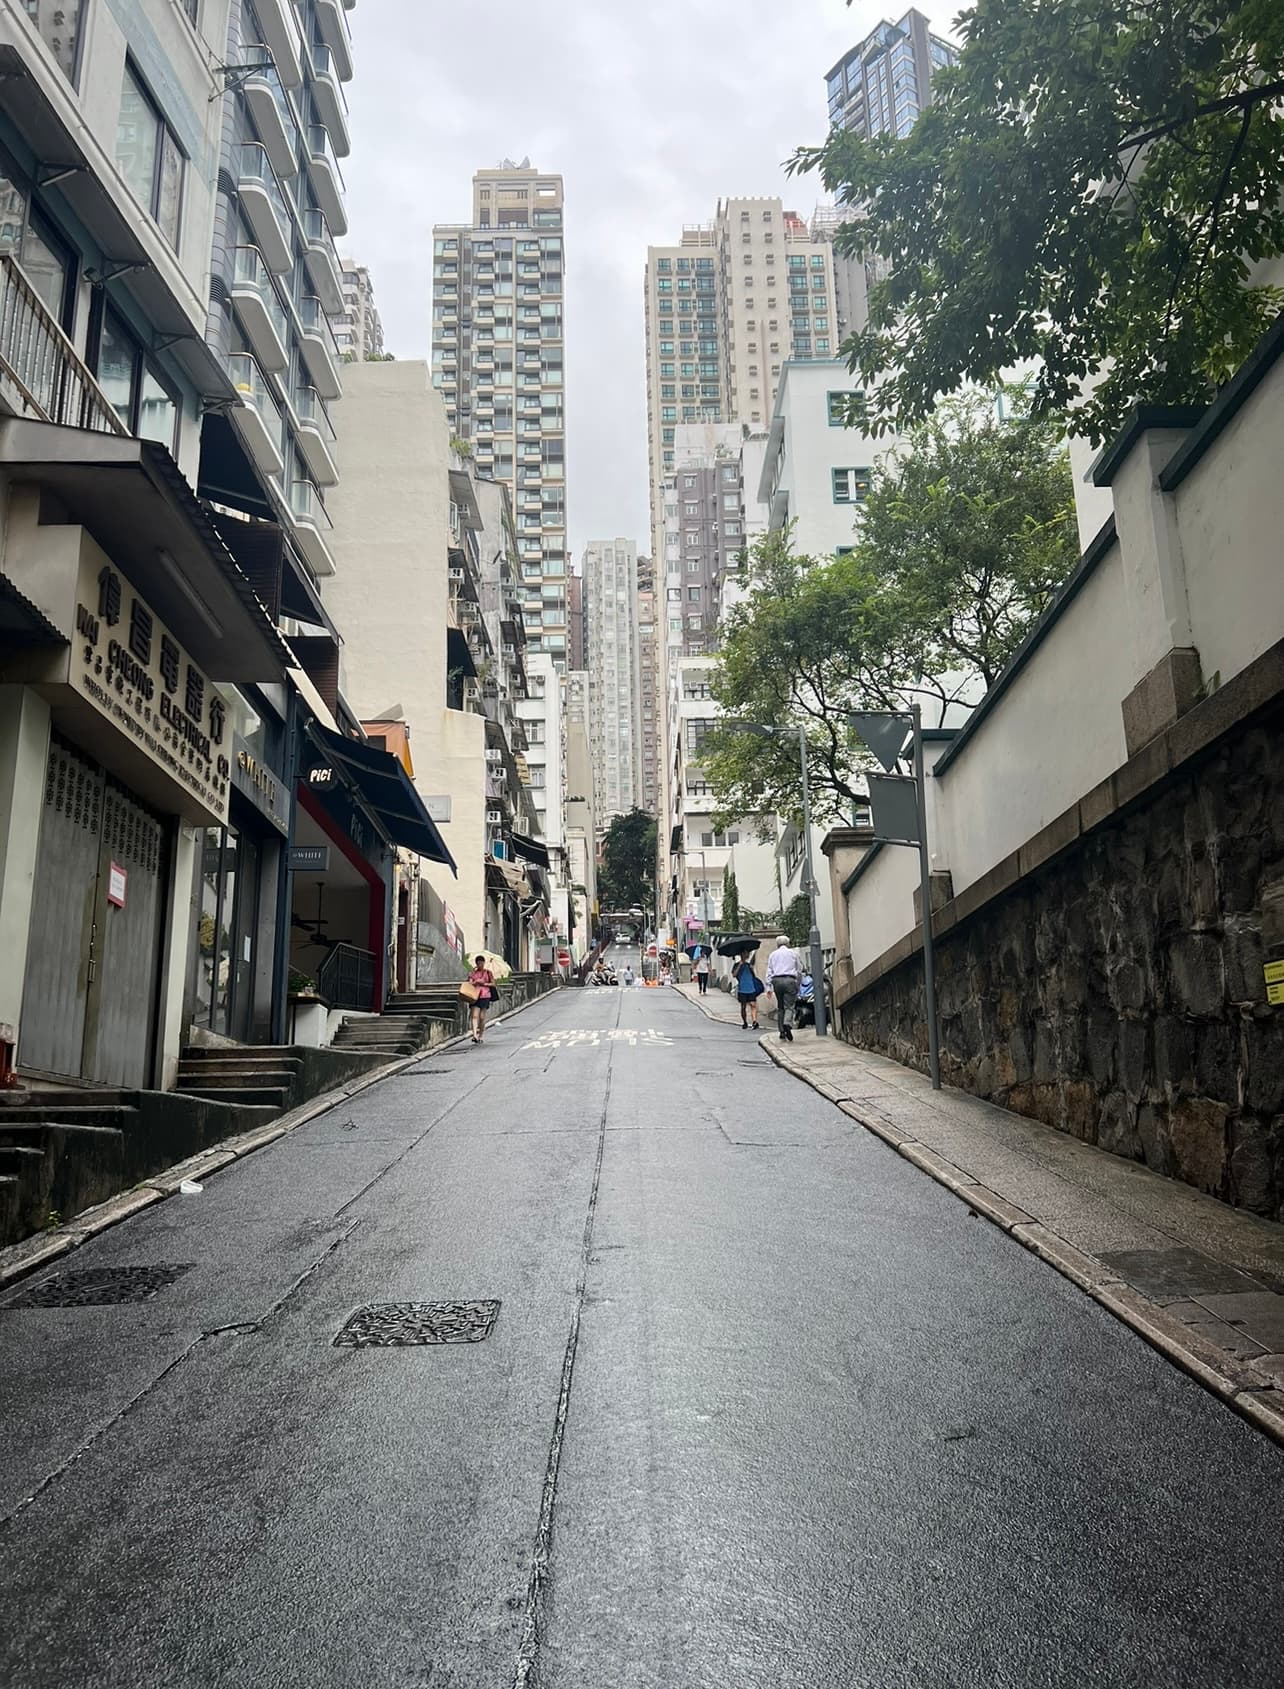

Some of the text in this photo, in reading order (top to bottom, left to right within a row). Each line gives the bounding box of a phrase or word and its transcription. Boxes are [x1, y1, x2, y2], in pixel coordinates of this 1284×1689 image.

[77, 603, 99, 646] WAI
[108, 639, 154, 701] CHEONG
[160, 691, 212, 764] ELECTRICAL
[98, 566, 226, 745] 偉昌電器行
